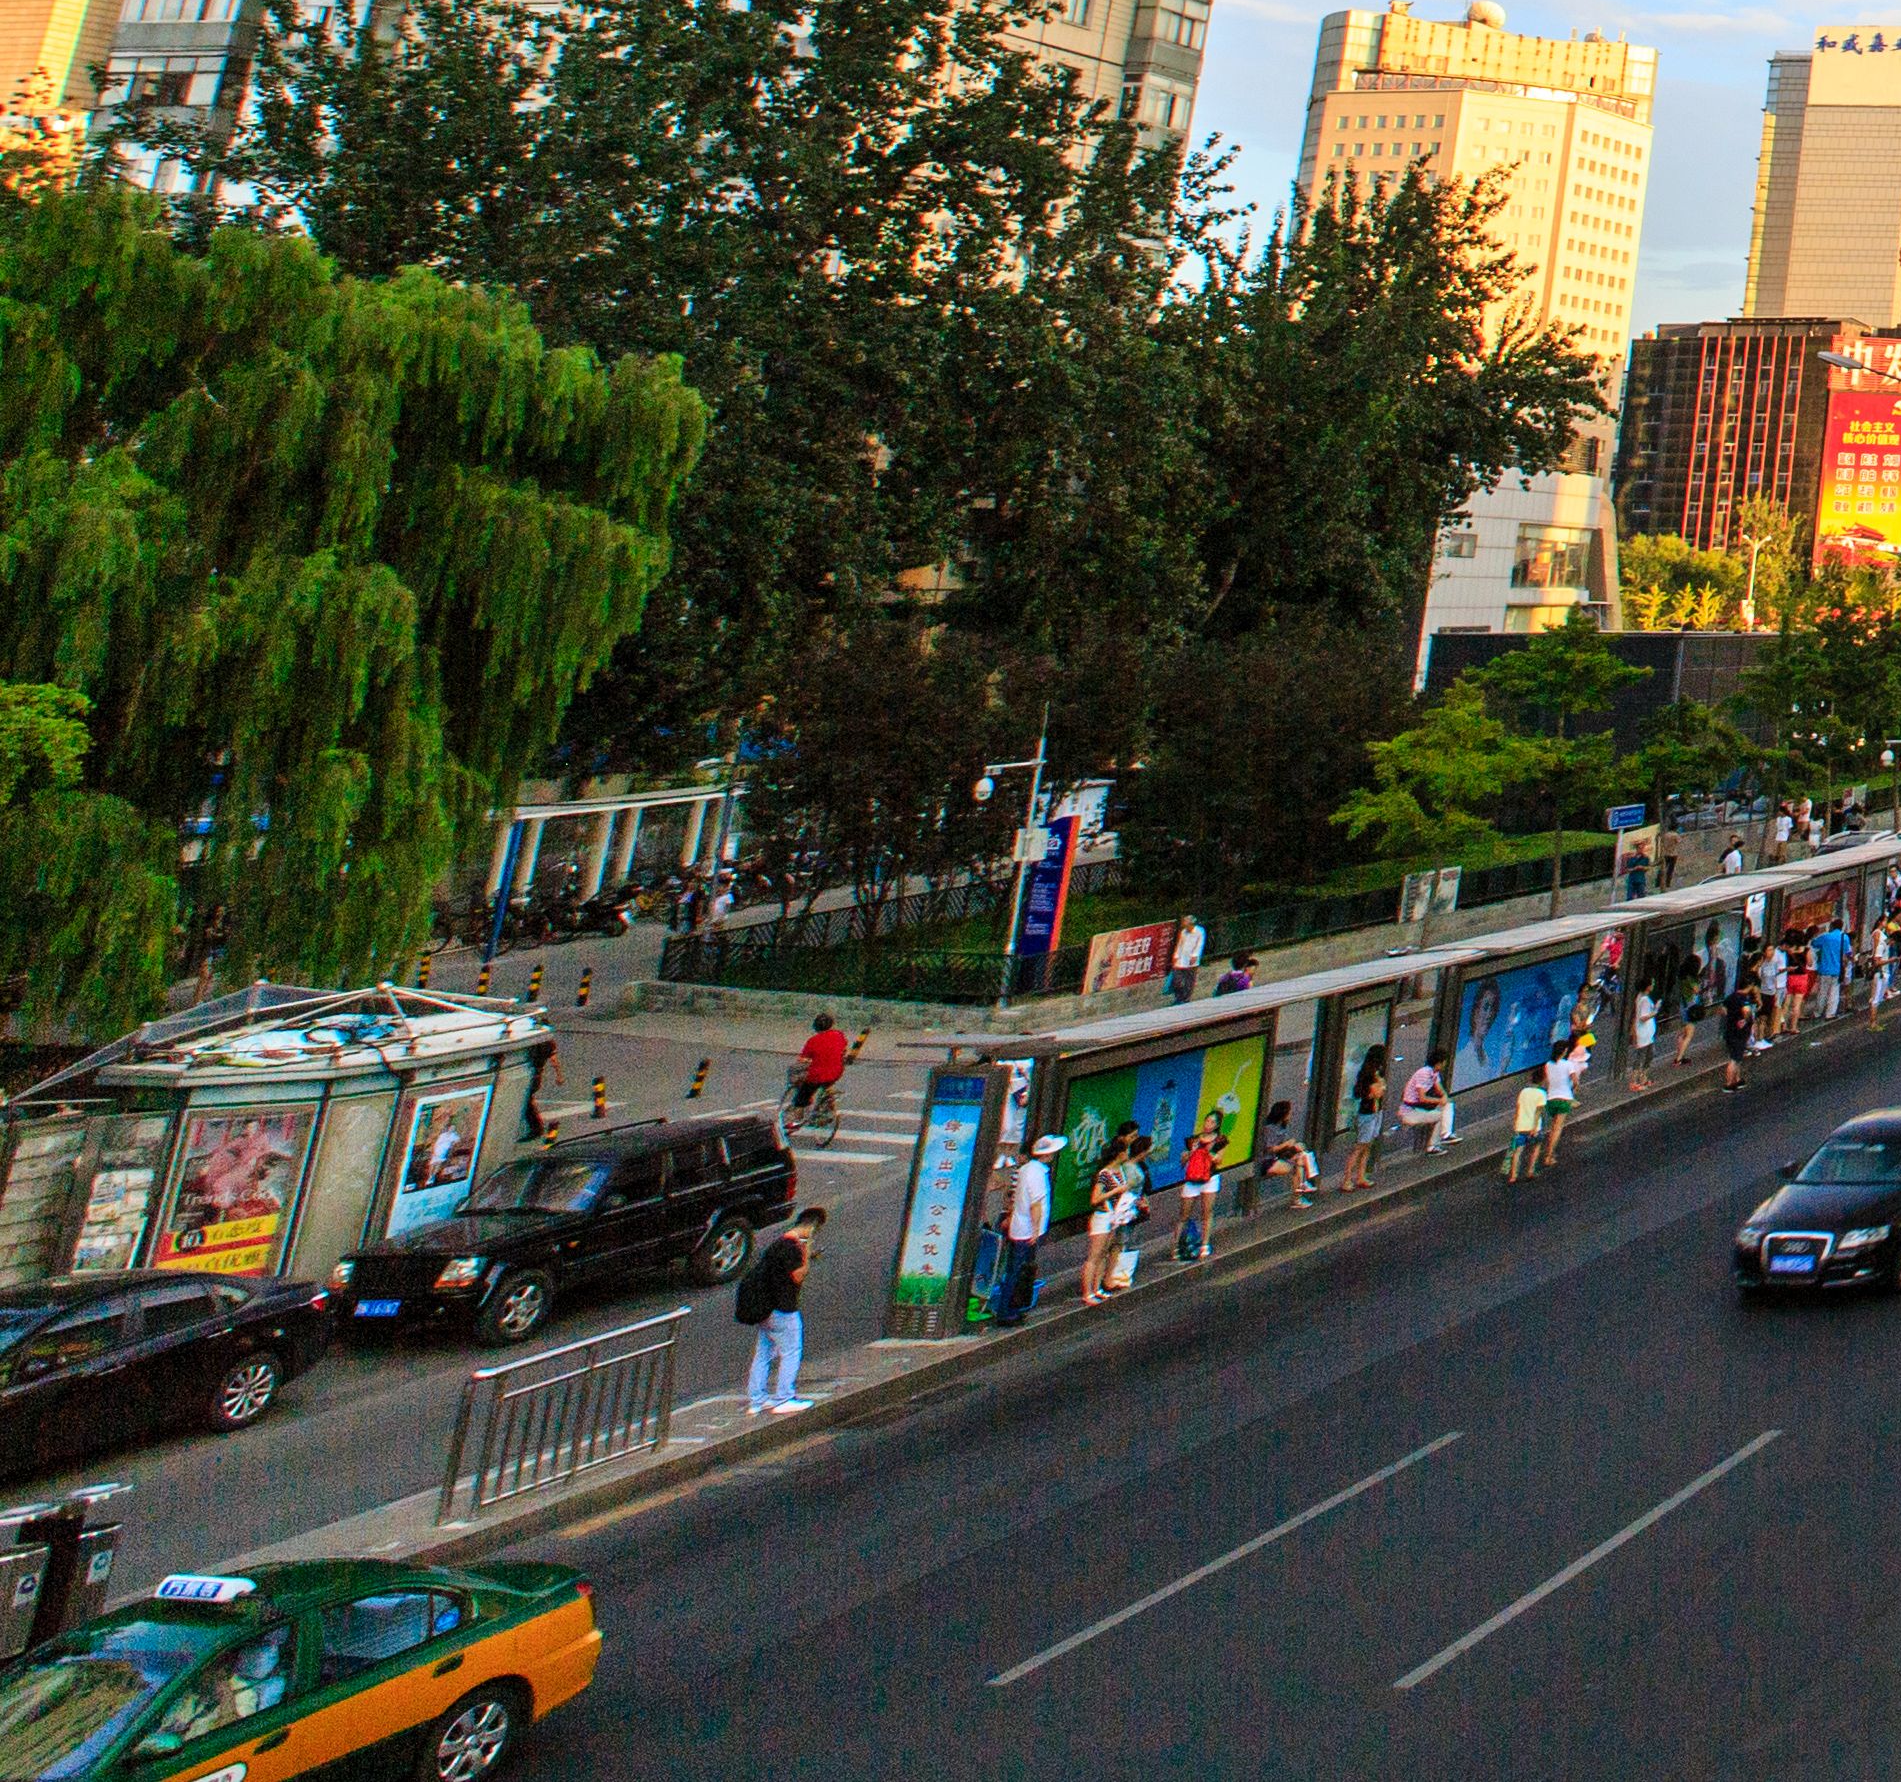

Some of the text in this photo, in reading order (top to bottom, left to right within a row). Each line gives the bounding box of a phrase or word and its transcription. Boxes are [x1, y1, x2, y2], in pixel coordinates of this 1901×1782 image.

[1842, 432, 1900, 446] 核心价值观
[1849, 421, 1896, 434] 社会主义
[934, 1118, 963, 1191] 绿色出行
[918, 1204, 947, 1277] 公交优先
